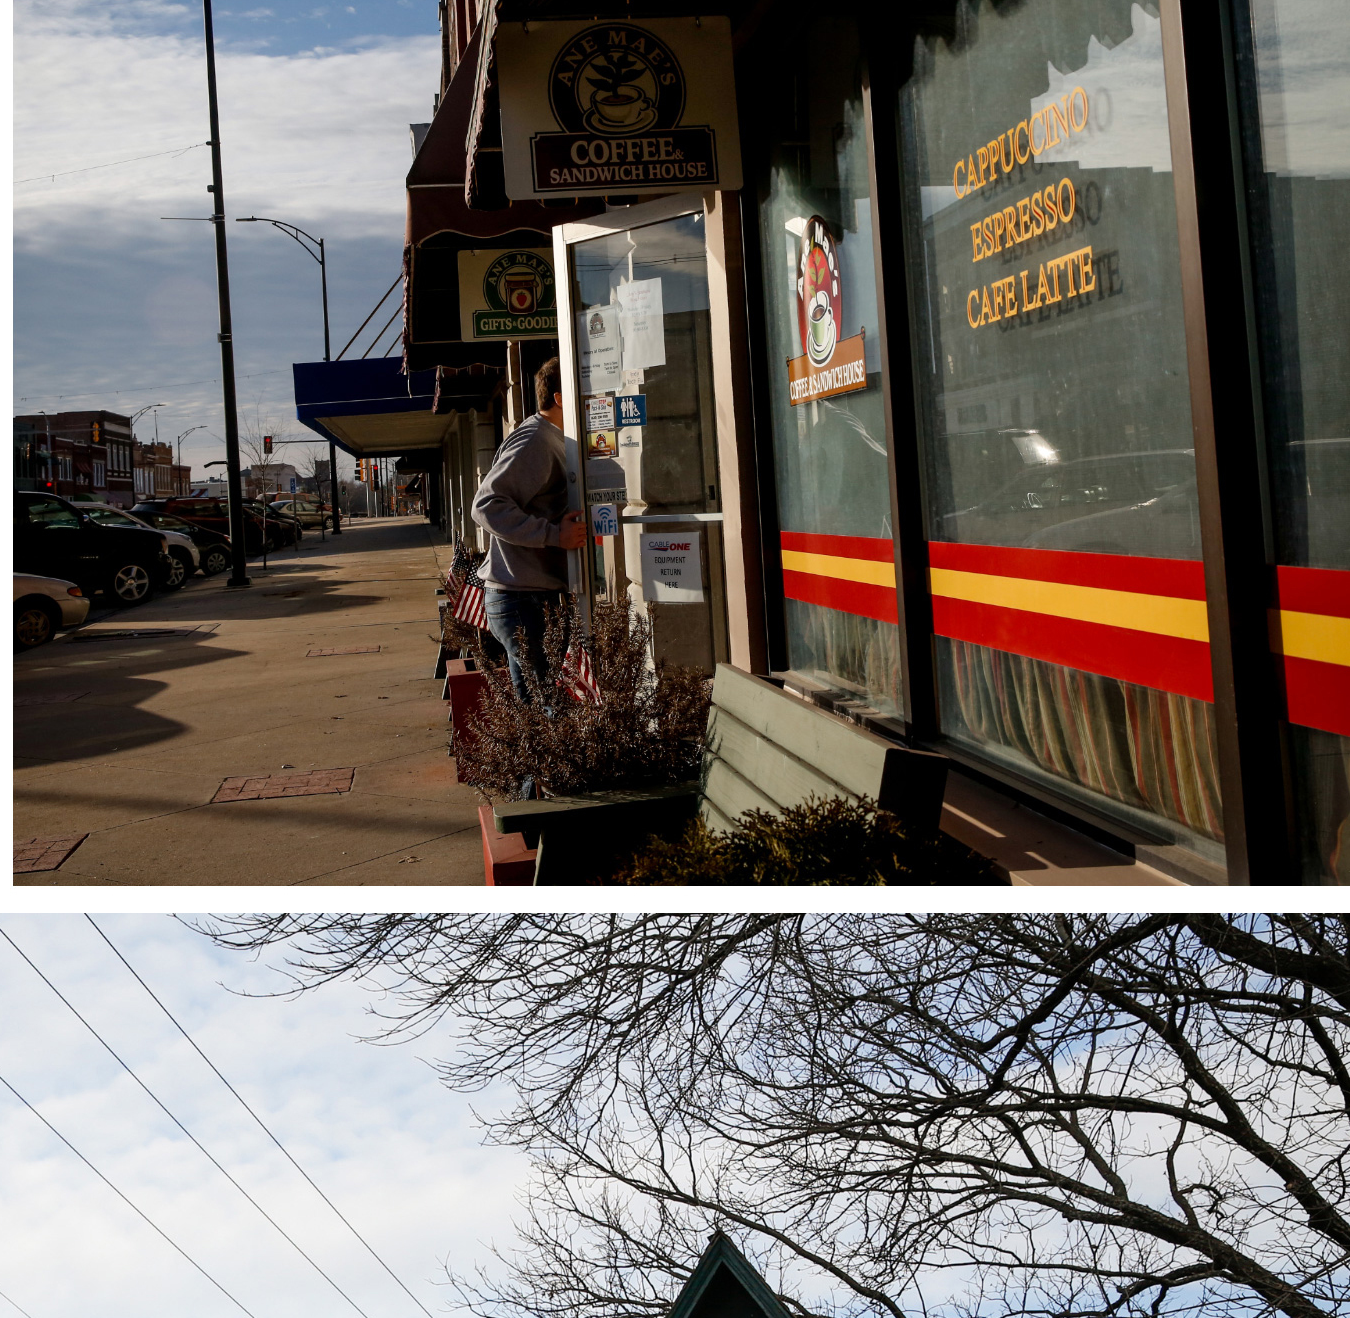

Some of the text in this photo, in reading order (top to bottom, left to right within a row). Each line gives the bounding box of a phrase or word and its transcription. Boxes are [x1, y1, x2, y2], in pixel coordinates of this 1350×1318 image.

[558, 30, 676, 87] ANE MAE'S
[570, 137, 684, 165] COFFEE &
[953, 86, 1088, 199] CAPPUCCINO
[550, 162, 708, 184] SANDWICH HOUSE
[970, 177, 1076, 262] ESPRESSO
[488, 254, 553, 286] ANE MAE'S
[815, 221, 839, 297] Mae's
[967, 246, 1096, 329] CAFE LATTE
[480, 318, 512, 331] GIFTS
[790, 378, 808, 400] COFFEE
[812, 365, 843, 393] SANDWICH
[843, 360, 865, 387] HOUSE
[616, 491, 626, 501] STE
[594, 520, 617, 534] WiFi
[654, 556, 686, 564] EQUIPMENT
[660, 568, 681, 576] RETURN
[664, 581, 678, 589] HERE
